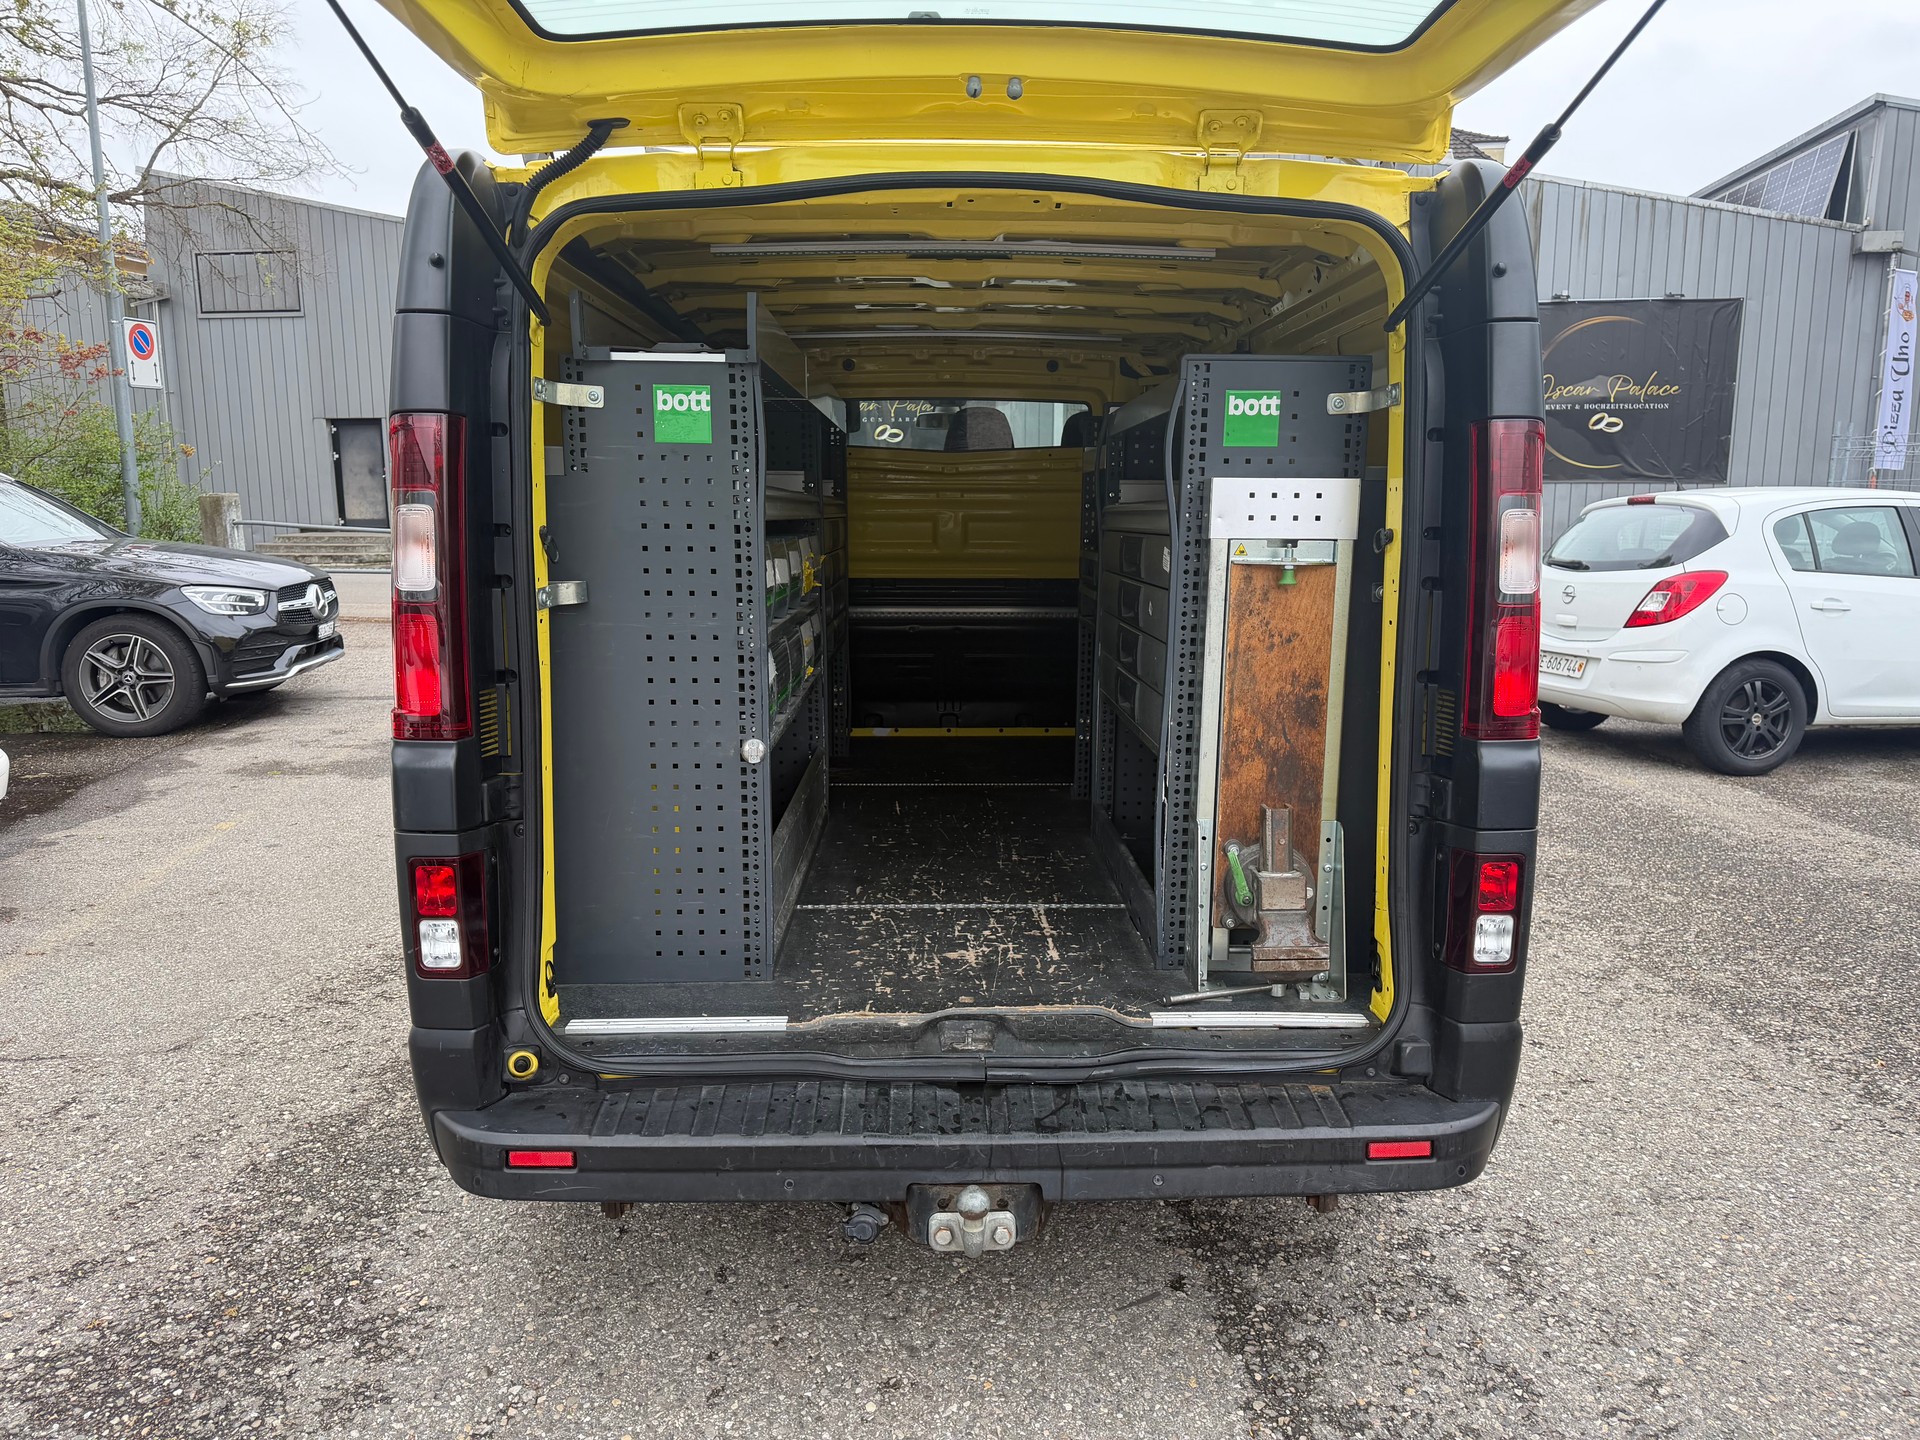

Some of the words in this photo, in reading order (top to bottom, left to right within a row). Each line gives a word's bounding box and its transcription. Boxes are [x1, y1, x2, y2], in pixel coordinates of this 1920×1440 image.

[1890, 331, 1910, 382] Uno
[656, 390, 711, 412] bott
[1607, 371, 1682, 403] Palace
[1228, 395, 1281, 416] bott
[1882, 389, 1905, 454] Pizza
